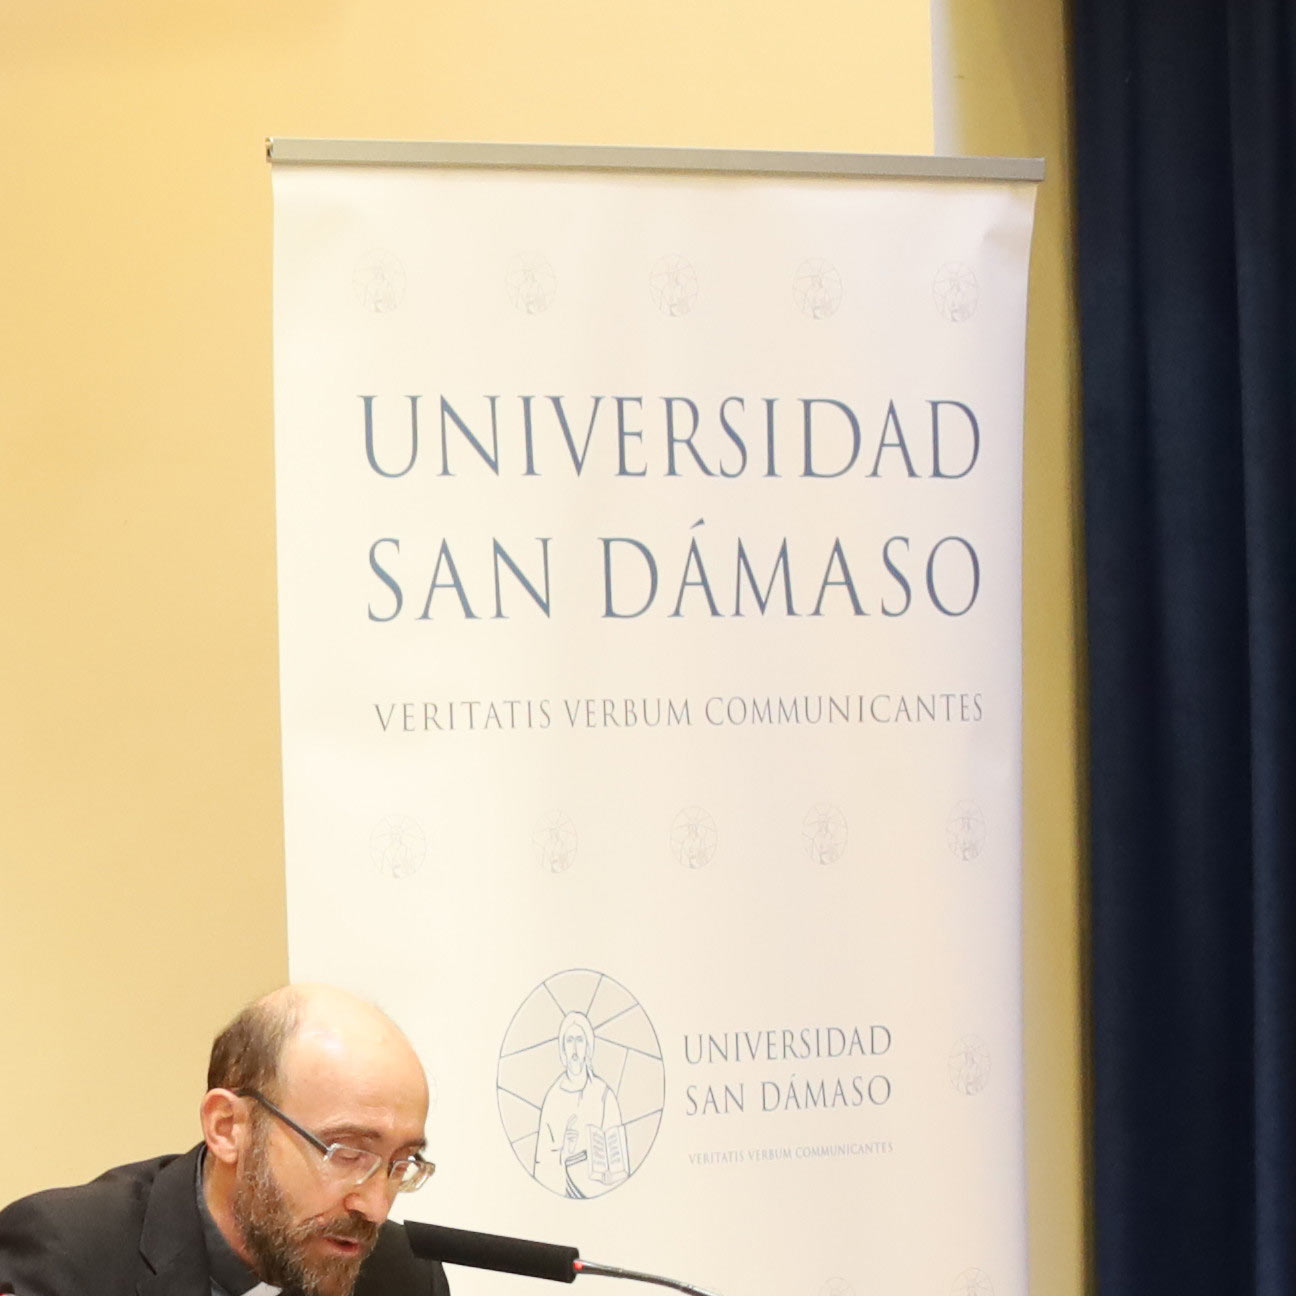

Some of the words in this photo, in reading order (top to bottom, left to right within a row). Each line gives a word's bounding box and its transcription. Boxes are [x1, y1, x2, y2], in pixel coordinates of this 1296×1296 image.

[358, 394, 981, 480] UNIVERSIDAD
[367, 537, 553, 623] SAN
[598, 518, 981, 621] DÁMASO
[374, 699, 551, 732] VERITATIS
[564, 698, 692, 728] VERBUM
[704, 693, 983, 727] COMMUNICANTES
[683, 1024, 892, 1066] UNIVERSIDAD
[686, 1082, 745, 1116] SAN
[761, 1073, 892, 1113] DÁMASO
[688, 1150, 744, 1165] VERITATIS
[748, 1147, 792, 1162] VERBUM
[796, 1142, 893, 1160] COMMUNICANTES
